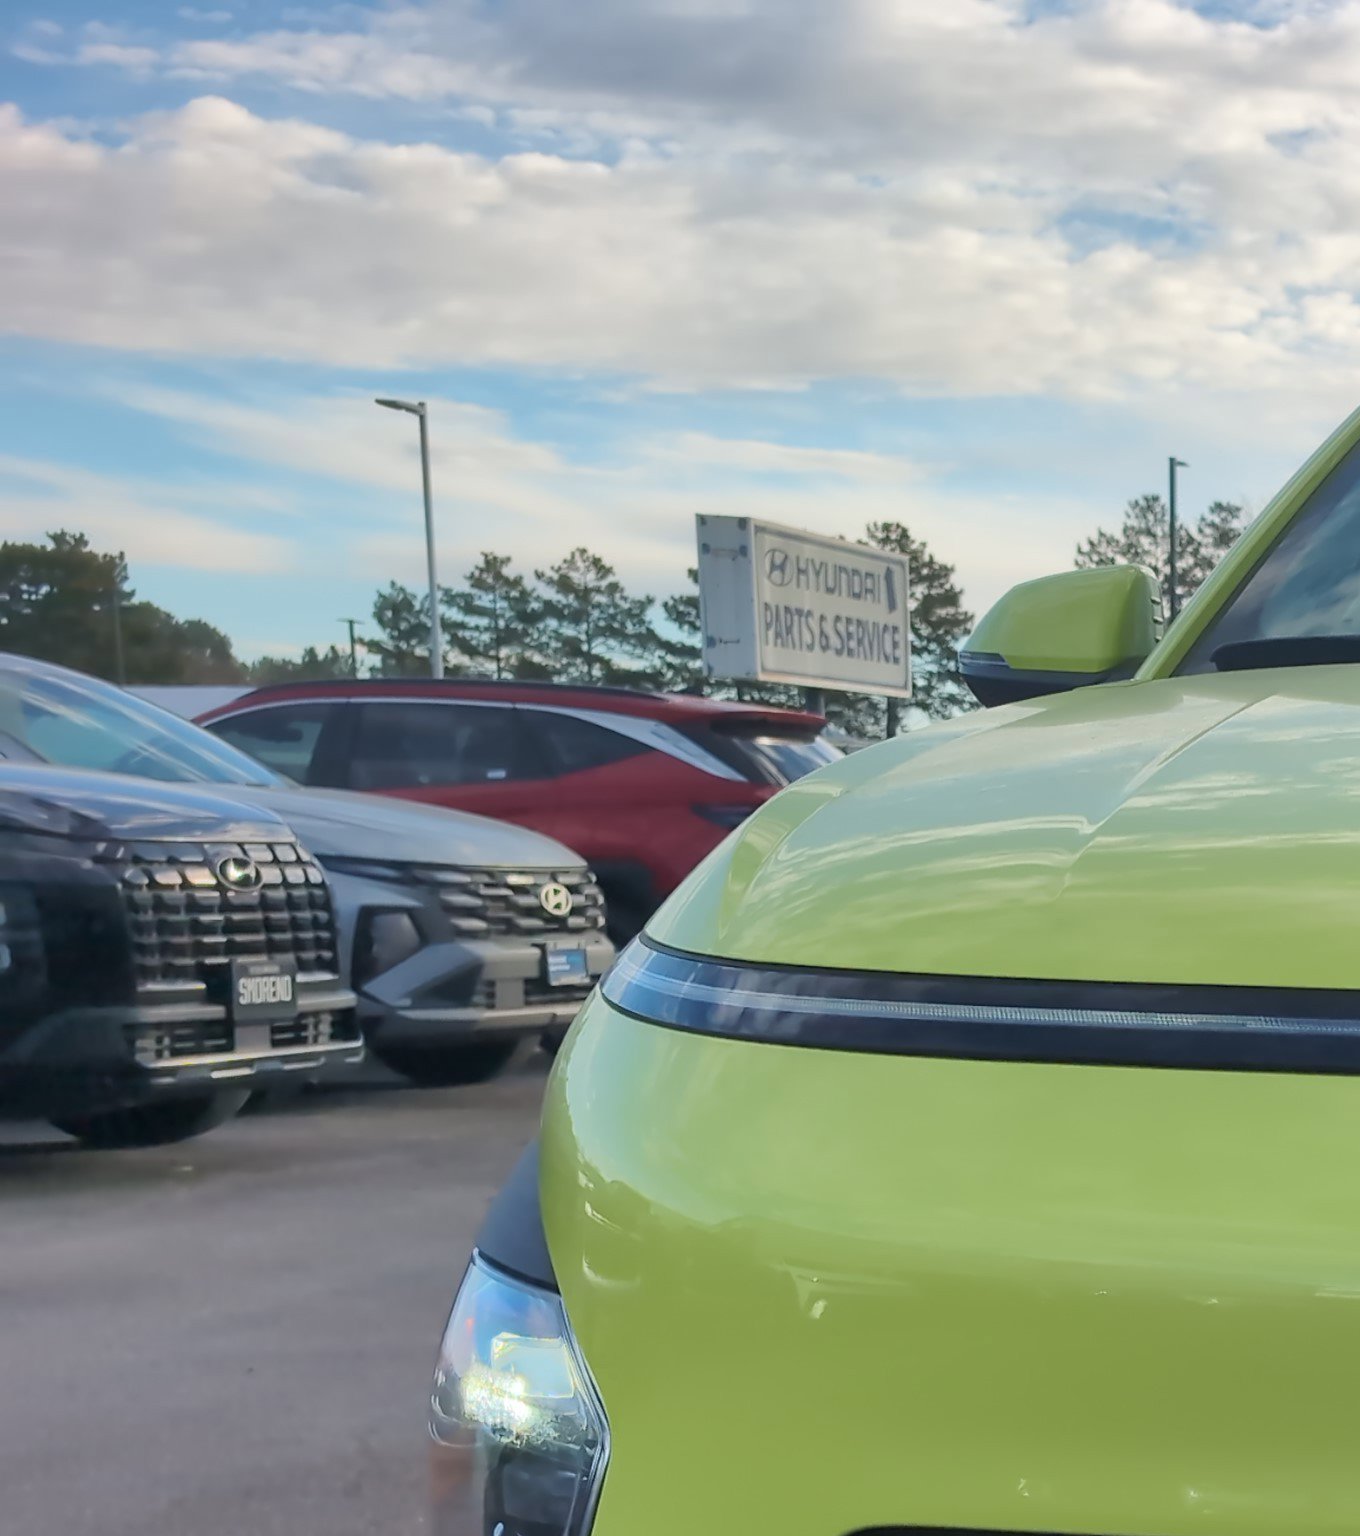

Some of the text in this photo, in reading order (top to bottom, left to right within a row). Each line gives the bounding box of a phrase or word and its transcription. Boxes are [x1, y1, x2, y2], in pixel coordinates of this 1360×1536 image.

[796, 555, 881, 604] HYUNDAI
[763, 602, 900, 665] PARTS & SERVICE
